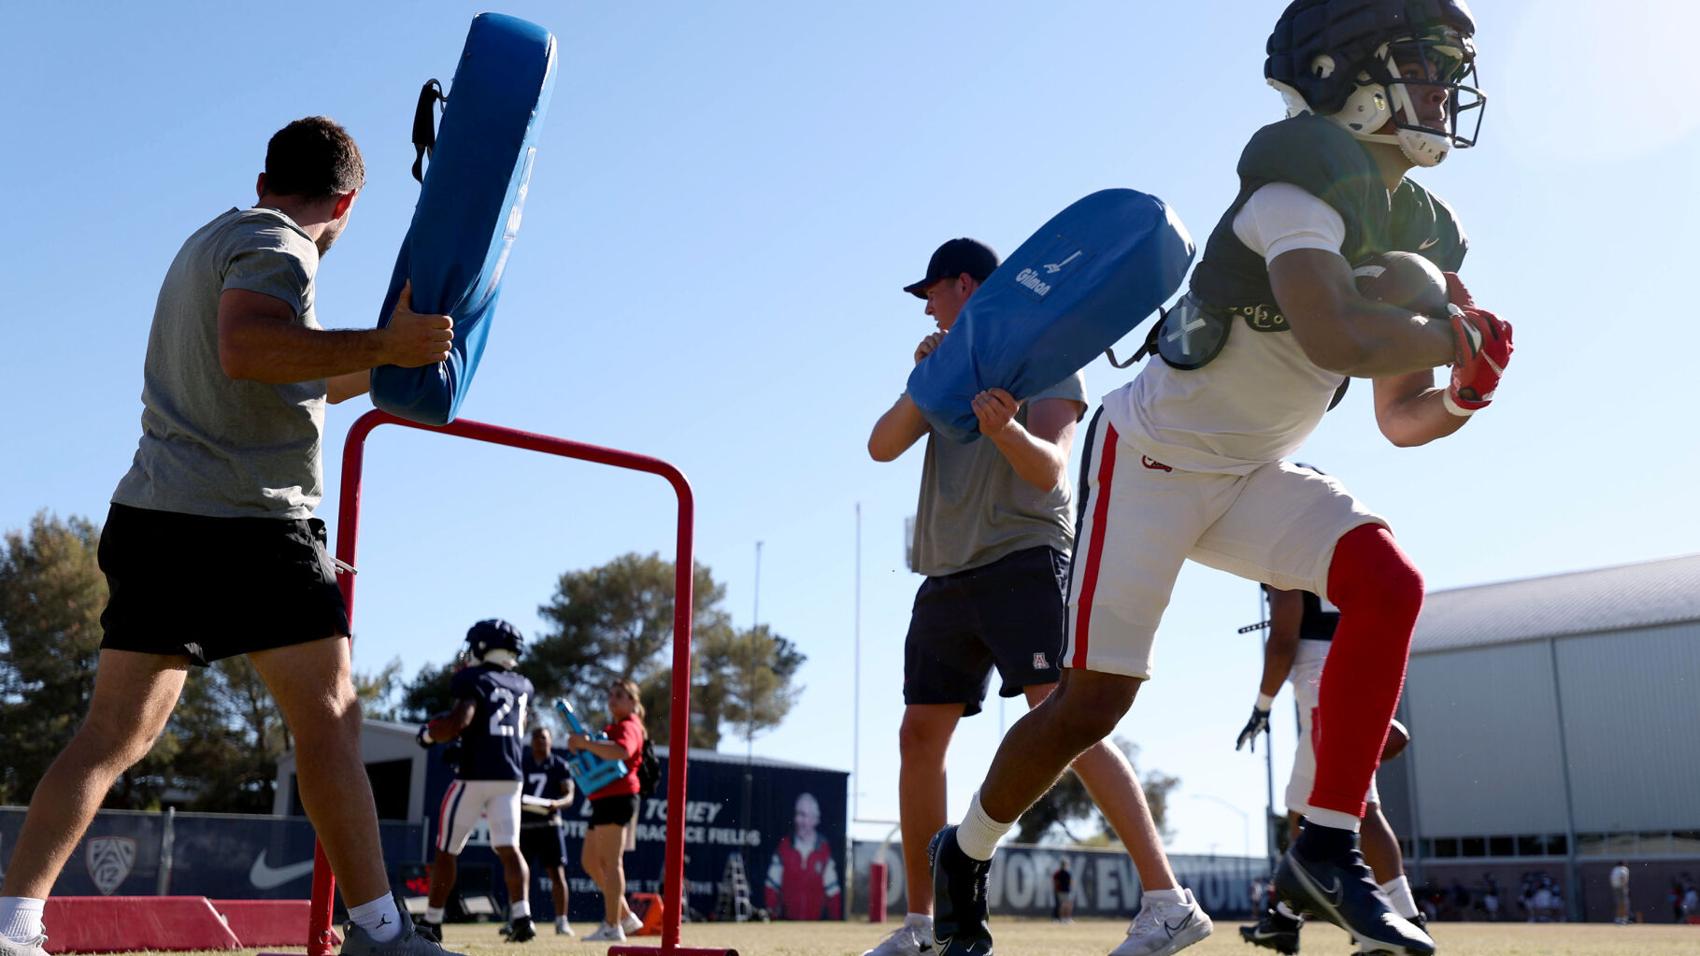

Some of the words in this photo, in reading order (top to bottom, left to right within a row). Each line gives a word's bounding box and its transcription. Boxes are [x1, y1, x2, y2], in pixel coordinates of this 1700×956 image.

[489, 687, 528, 739] 21
[528, 772, 547, 798] 7
[988, 848, 1089, 911] ORK
